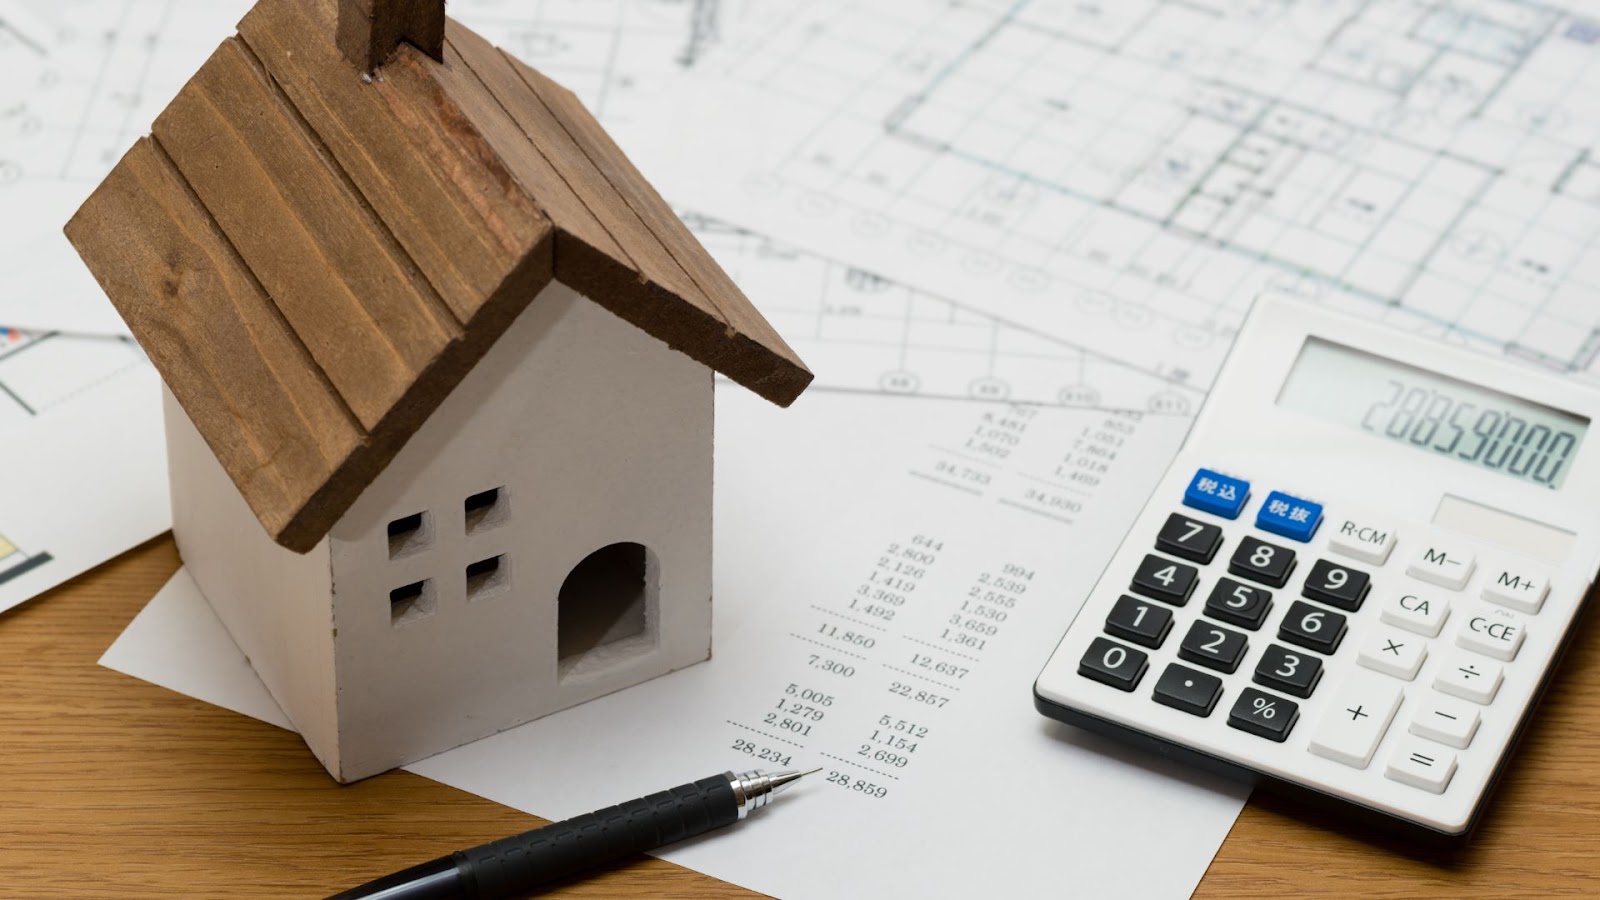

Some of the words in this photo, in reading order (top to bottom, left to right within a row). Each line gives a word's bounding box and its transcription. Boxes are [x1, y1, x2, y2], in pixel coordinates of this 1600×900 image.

[1197, 477, 1236, 501] 税込
[1268, 499, 1311, 523] 税抜
[912, 534, 944, 553] 644
[1178, 521, 1204, 542] 7
[887, 543, 935, 566] 2,800
[1249, 545, 1276, 568] 8
[877, 556, 926, 580] 2,126
[1003, 562, 1036, 582] 994
[1153, 565, 1177, 587] 4
[1324, 568, 1351, 591] 9
[868, 571, 916, 594] 1,419
[978, 572, 1027, 595] 2,539
[1497, 571, 1536, 590] M+
[857, 584, 906, 607] 3,369
[969, 586, 1016, 609] 2,555
[1226, 585, 1250, 609] 5
[1399, 595, 1430, 615] CA
[848, 598, 896, 622] 1,492
[959, 600, 1008, 624] 1,530
[1133, 606, 1149, 628] 1
[949, 614, 998, 637] 3,659
[1300, 611, 1325, 634] 6
[818, 623, 876, 650] 11,850
[940, 628, 987, 651] 1,361
[1200, 630, 1224, 654] 2
[808, 654, 856, 678] 7,300
[910, 653, 970, 680] 12,637
[1102, 644, 1129, 669] 0
[1275, 654, 1300, 677] 3
[785, 683, 835, 708] 5,005
[888, 681, 950, 709] 22,857
[1253, 694, 1279, 719] %
[776, 698, 825, 722] 1,279
[763, 712, 812, 738] 2,801
[878, 714, 929, 739] 5,512
[731, 738, 793, 768] 28,234
[869, 729, 919, 754] 1,154
[857, 743, 909, 769] 2,699
[825, 770, 888, 799] 28,859
